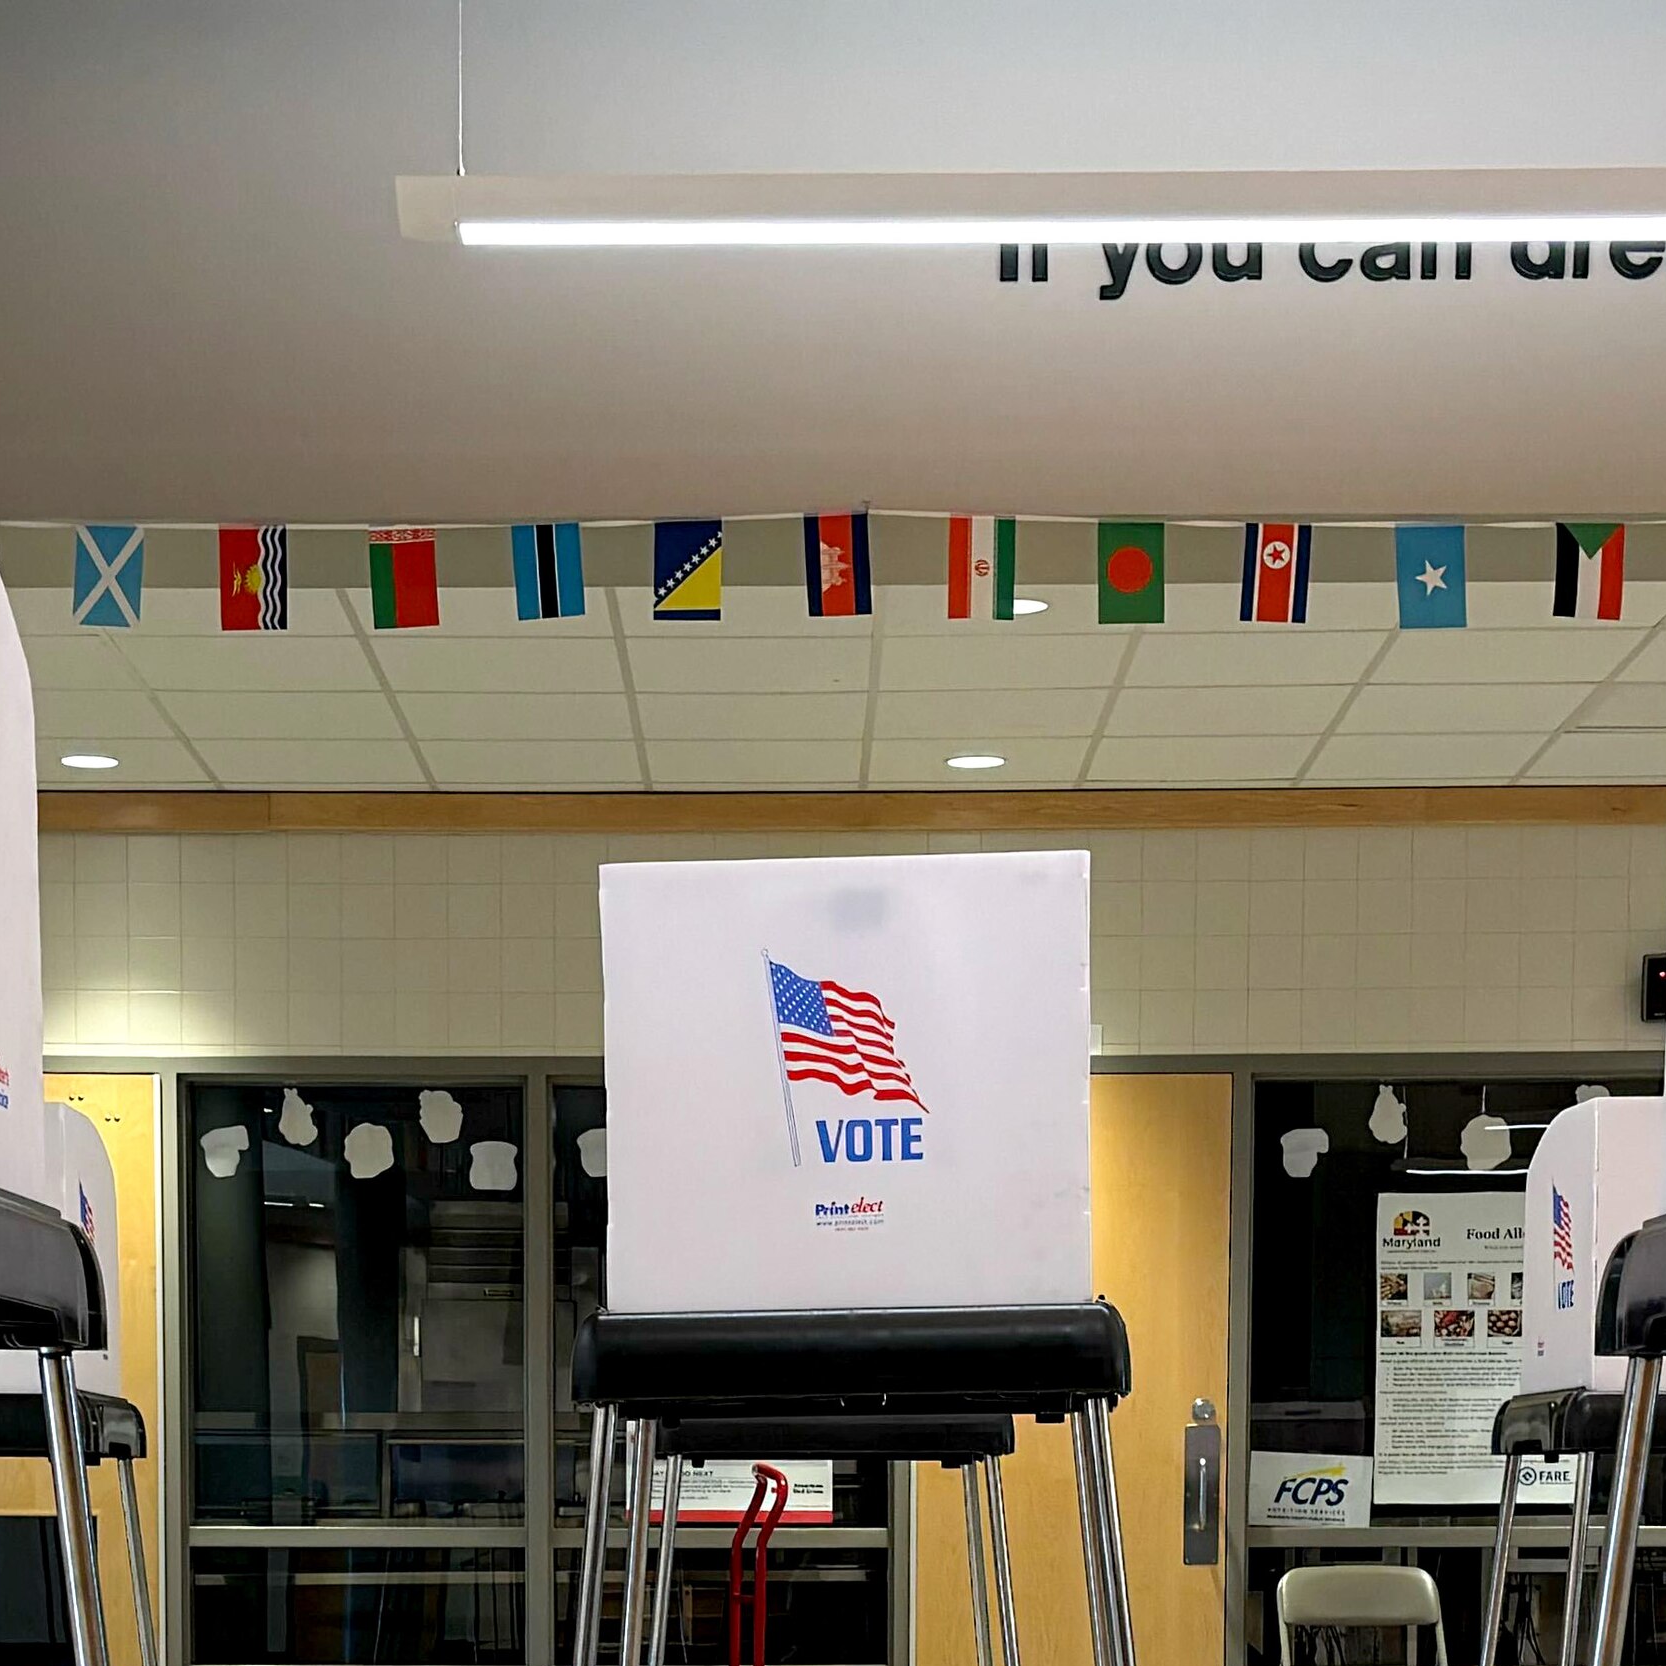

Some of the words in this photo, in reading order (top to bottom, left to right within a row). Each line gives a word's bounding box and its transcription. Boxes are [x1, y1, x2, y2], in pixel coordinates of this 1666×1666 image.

[816, 1117, 925, 1163] VOTE
[1466, 1227, 1501, 1241] Food
[1503, 1226, 1525, 1240] All
[1382, 1236, 1441, 1250] Maryland
[1539, 1470, 1572, 1482] FARE
[1274, 1477, 1349, 1506] FCPS
